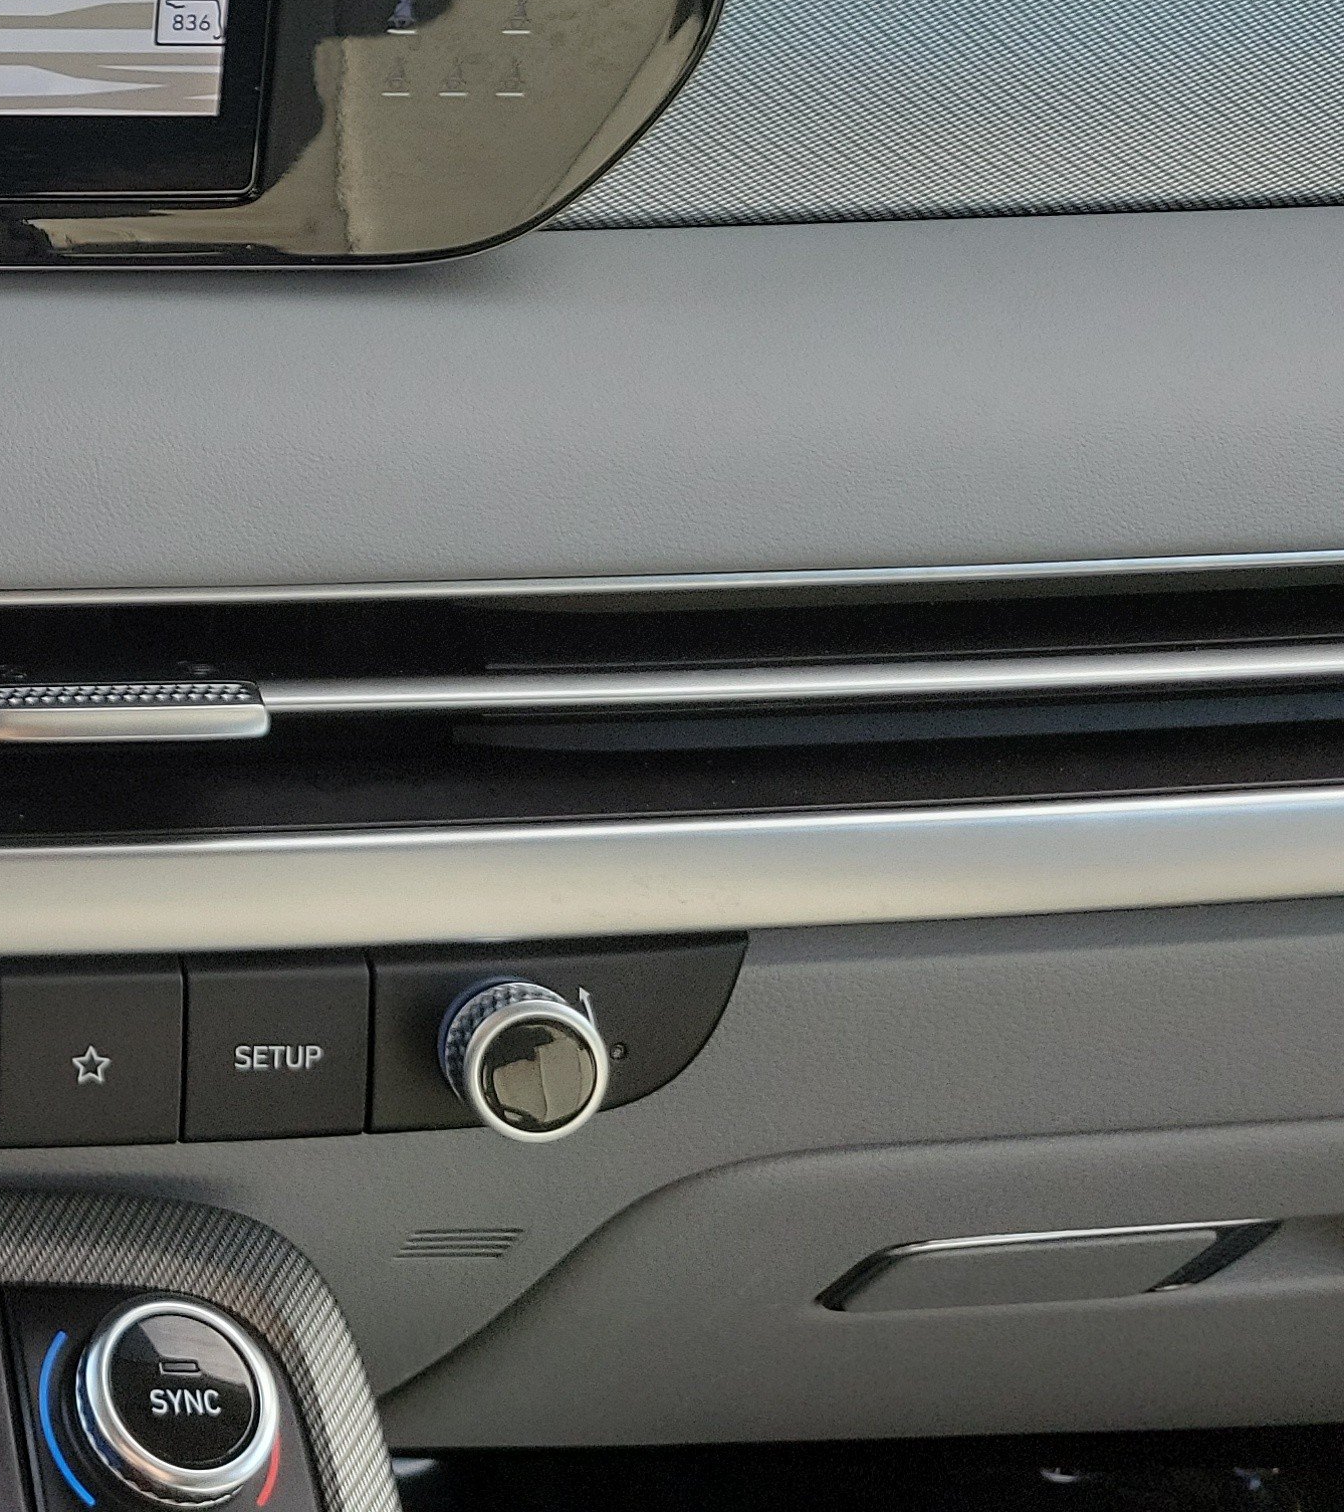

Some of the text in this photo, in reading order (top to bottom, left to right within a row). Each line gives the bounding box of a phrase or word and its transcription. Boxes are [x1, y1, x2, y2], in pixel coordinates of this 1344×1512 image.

[172, 14, 211, 32] 836
[234, 1044, 322, 1071] SETUP
[149, 1387, 222, 1419] SYNC
